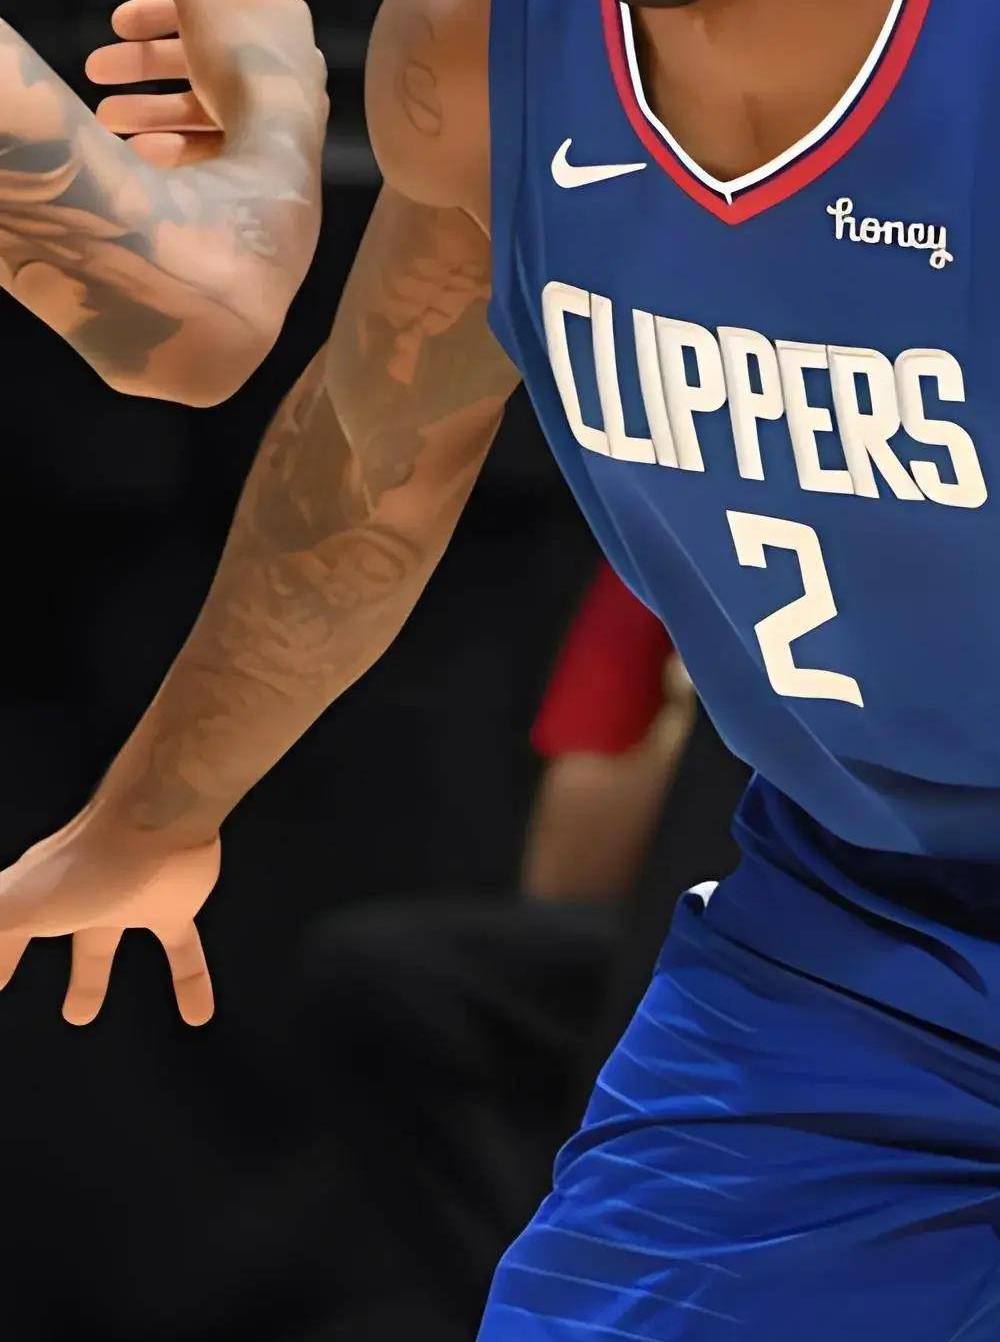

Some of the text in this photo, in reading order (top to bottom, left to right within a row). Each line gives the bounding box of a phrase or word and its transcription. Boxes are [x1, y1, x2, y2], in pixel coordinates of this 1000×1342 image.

[826, 197, 954, 270] honey
[541, 280, 989, 509] CLIPPERS
[725, 509, 864, 708] 2
